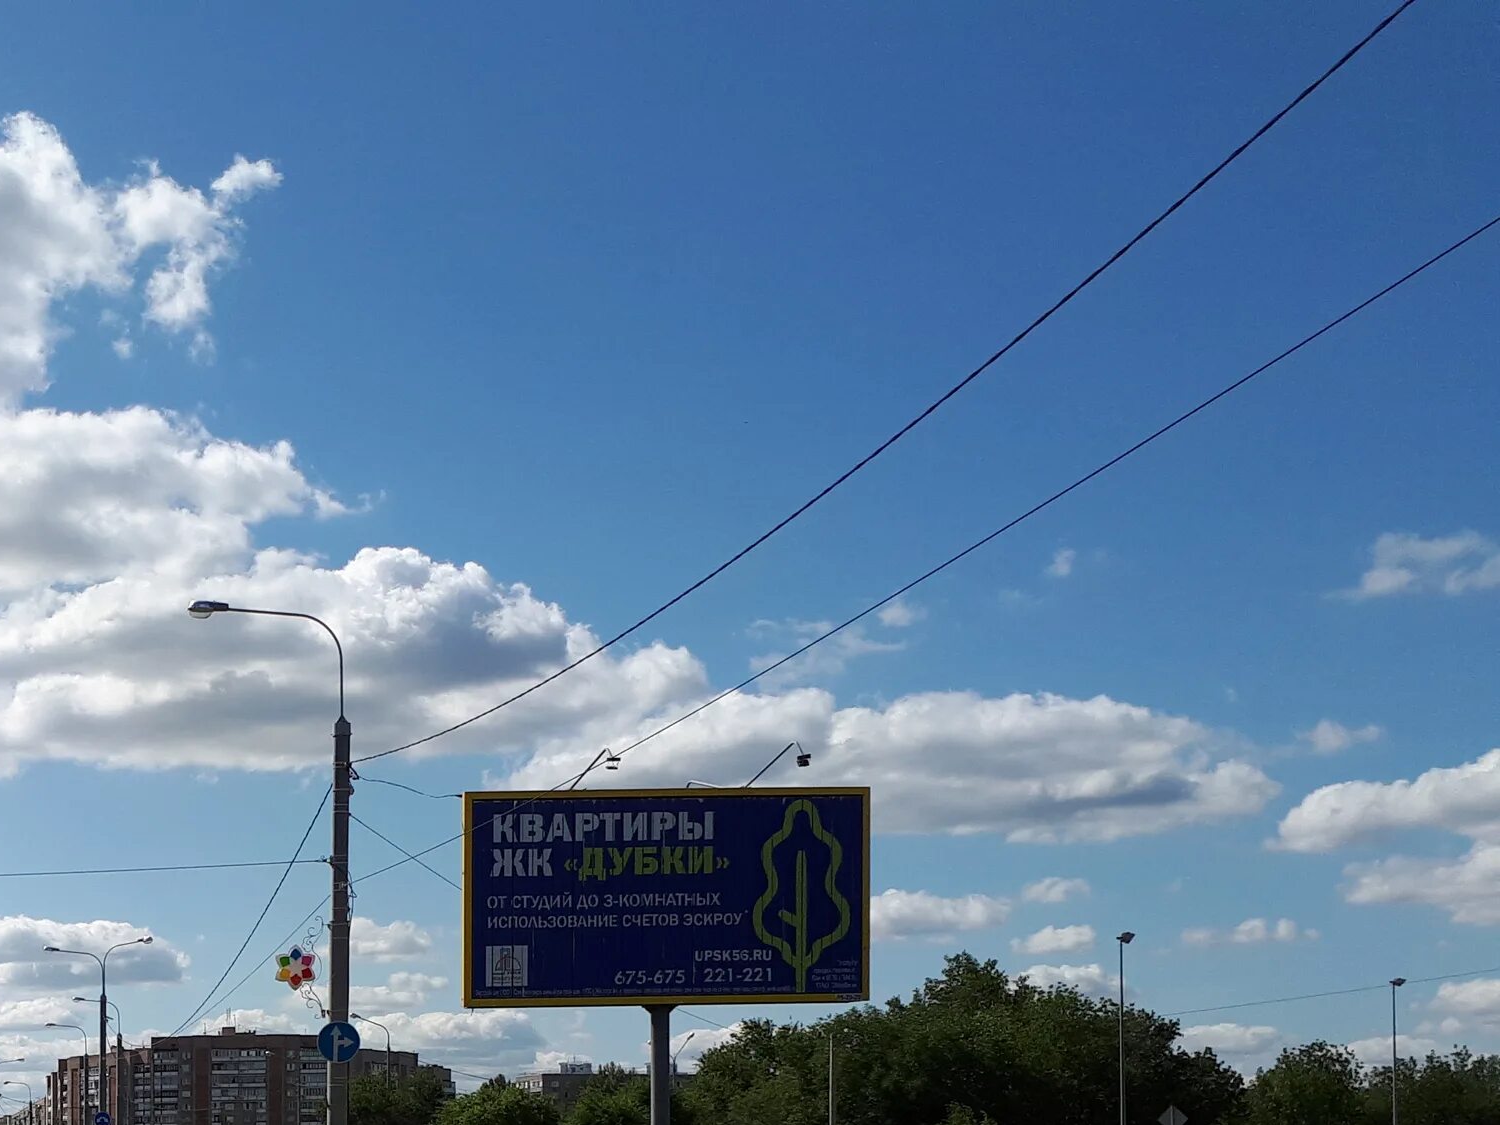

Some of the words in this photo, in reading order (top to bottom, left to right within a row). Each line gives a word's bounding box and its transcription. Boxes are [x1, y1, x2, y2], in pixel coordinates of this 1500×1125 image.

[492, 811, 716, 843] КВАРТИРЫ
[490, 848, 553, 877] ЖК
[563, 846, 730, 882] «ДУБКИ»
[487, 895, 507, 909] ОТ
[512, 891, 572, 911] СТУДИЙ
[576, 894, 599, 910] ДО
[603, 892, 721, 908] 3-КОМНАТНЫХ
[487, 914, 619, 929] ИСПОЛЬЗОВАНИЕ
[622, 912, 679, 928] СЧЕТОВ
[694, 949, 773, 962] UPSK56.RU
[614, 969, 686, 985] 675-675
[703, 967, 773, 983] 221-221
